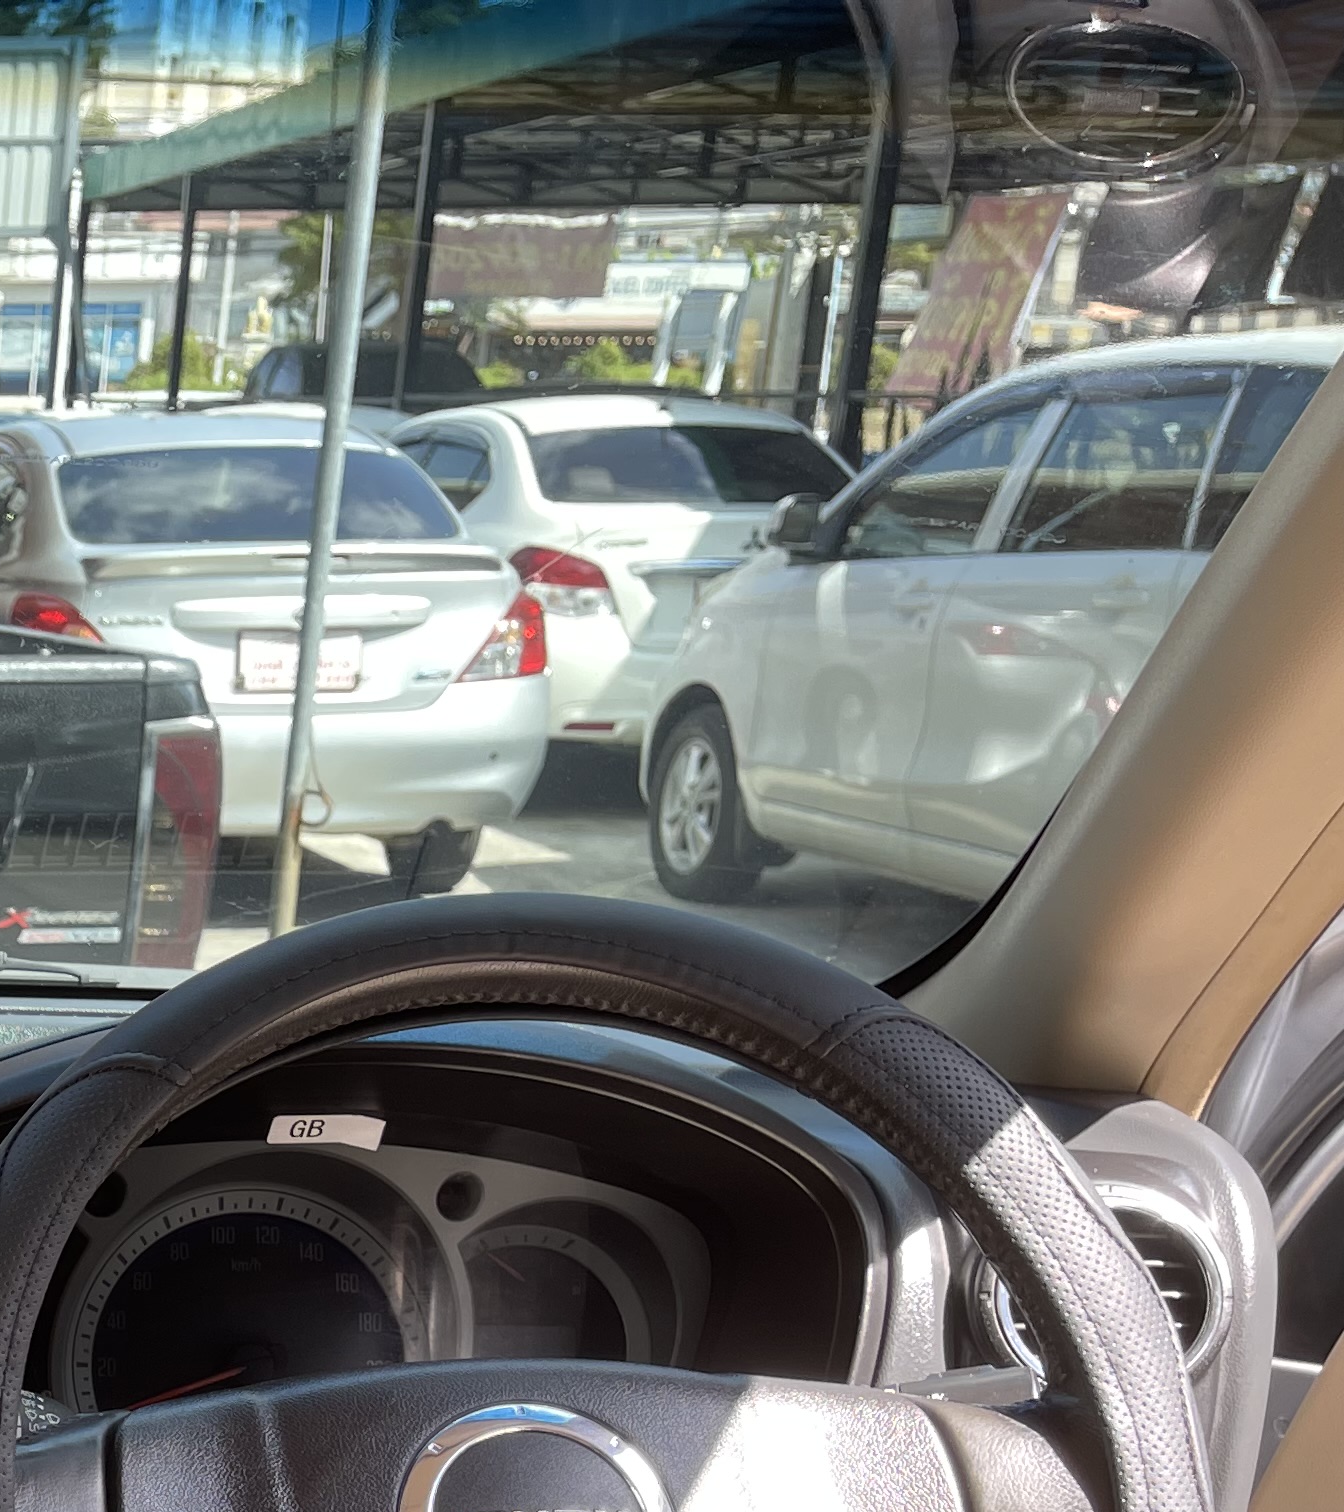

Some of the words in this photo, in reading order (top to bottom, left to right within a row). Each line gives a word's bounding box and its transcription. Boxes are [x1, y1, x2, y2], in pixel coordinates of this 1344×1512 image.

[290, 1119, 325, 1138] GB
[211, 1227, 235, 1245] 100
[256, 1227, 280, 1244] 120
[169, 1243, 189, 1260] 80
[299, 1244, 324, 1261] 140
[231, 1259, 261, 1272] km/h
[133, 1272, 152, 1290] 60
[335, 1273, 359, 1292] 160
[106, 1312, 126, 1329] 40
[358, 1313, 382, 1333] 180
[98, 1359, 117, 1376] 20
